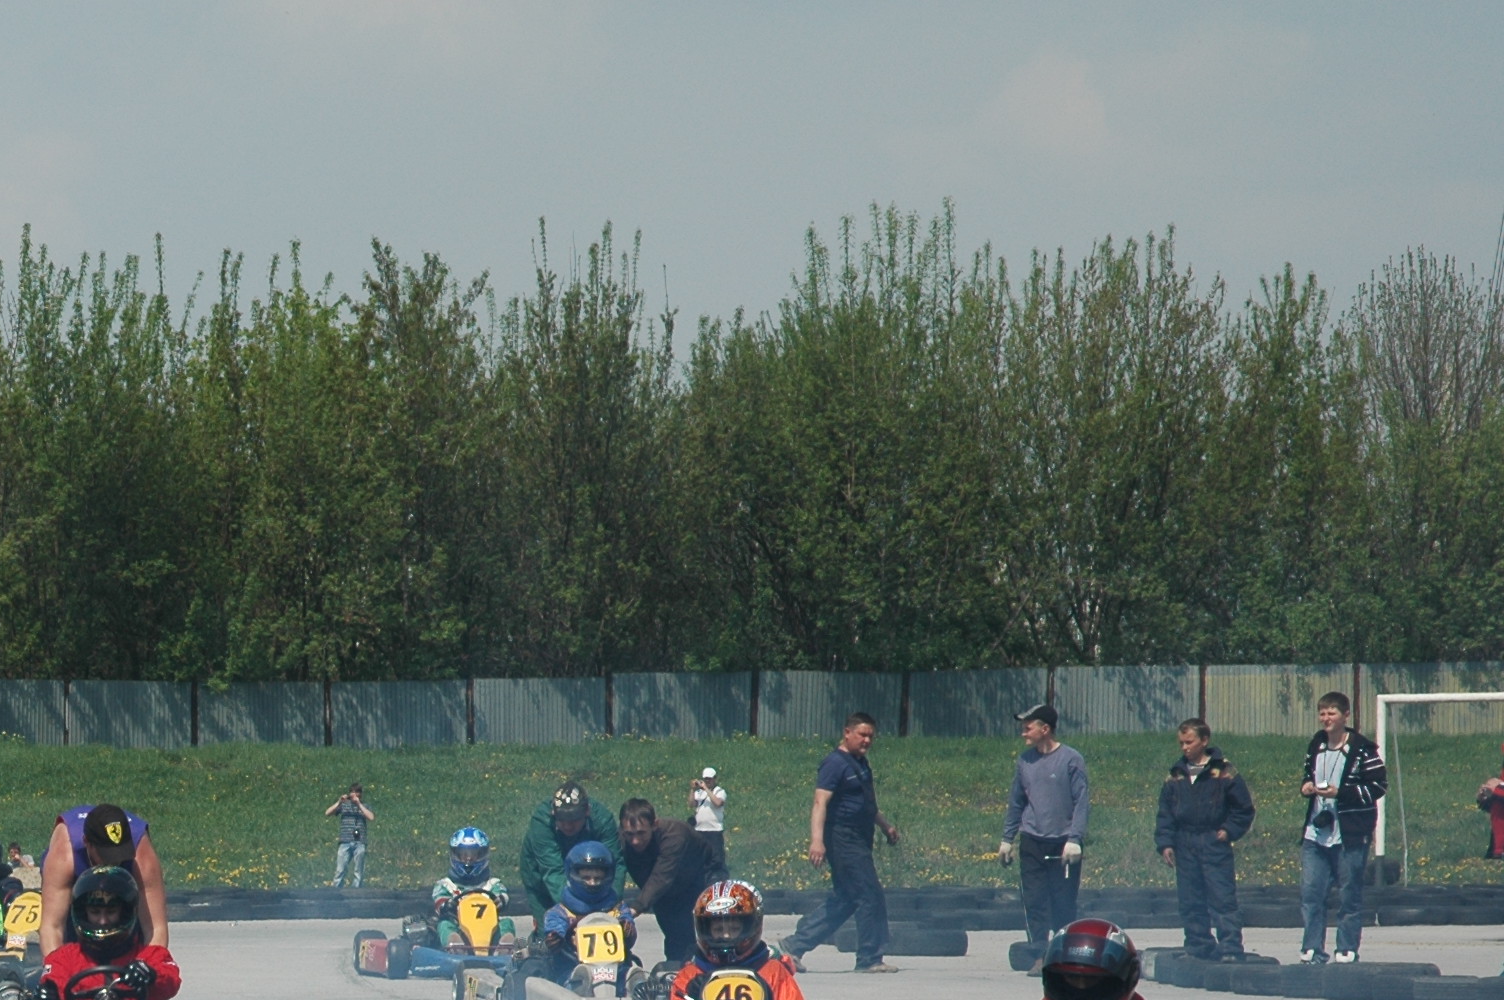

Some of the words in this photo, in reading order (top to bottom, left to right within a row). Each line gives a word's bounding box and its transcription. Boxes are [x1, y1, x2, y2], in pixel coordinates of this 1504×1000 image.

[11, 904, 39, 924] 75
[471, 904, 488, 919] 7
[583, 930, 618, 958] 79
